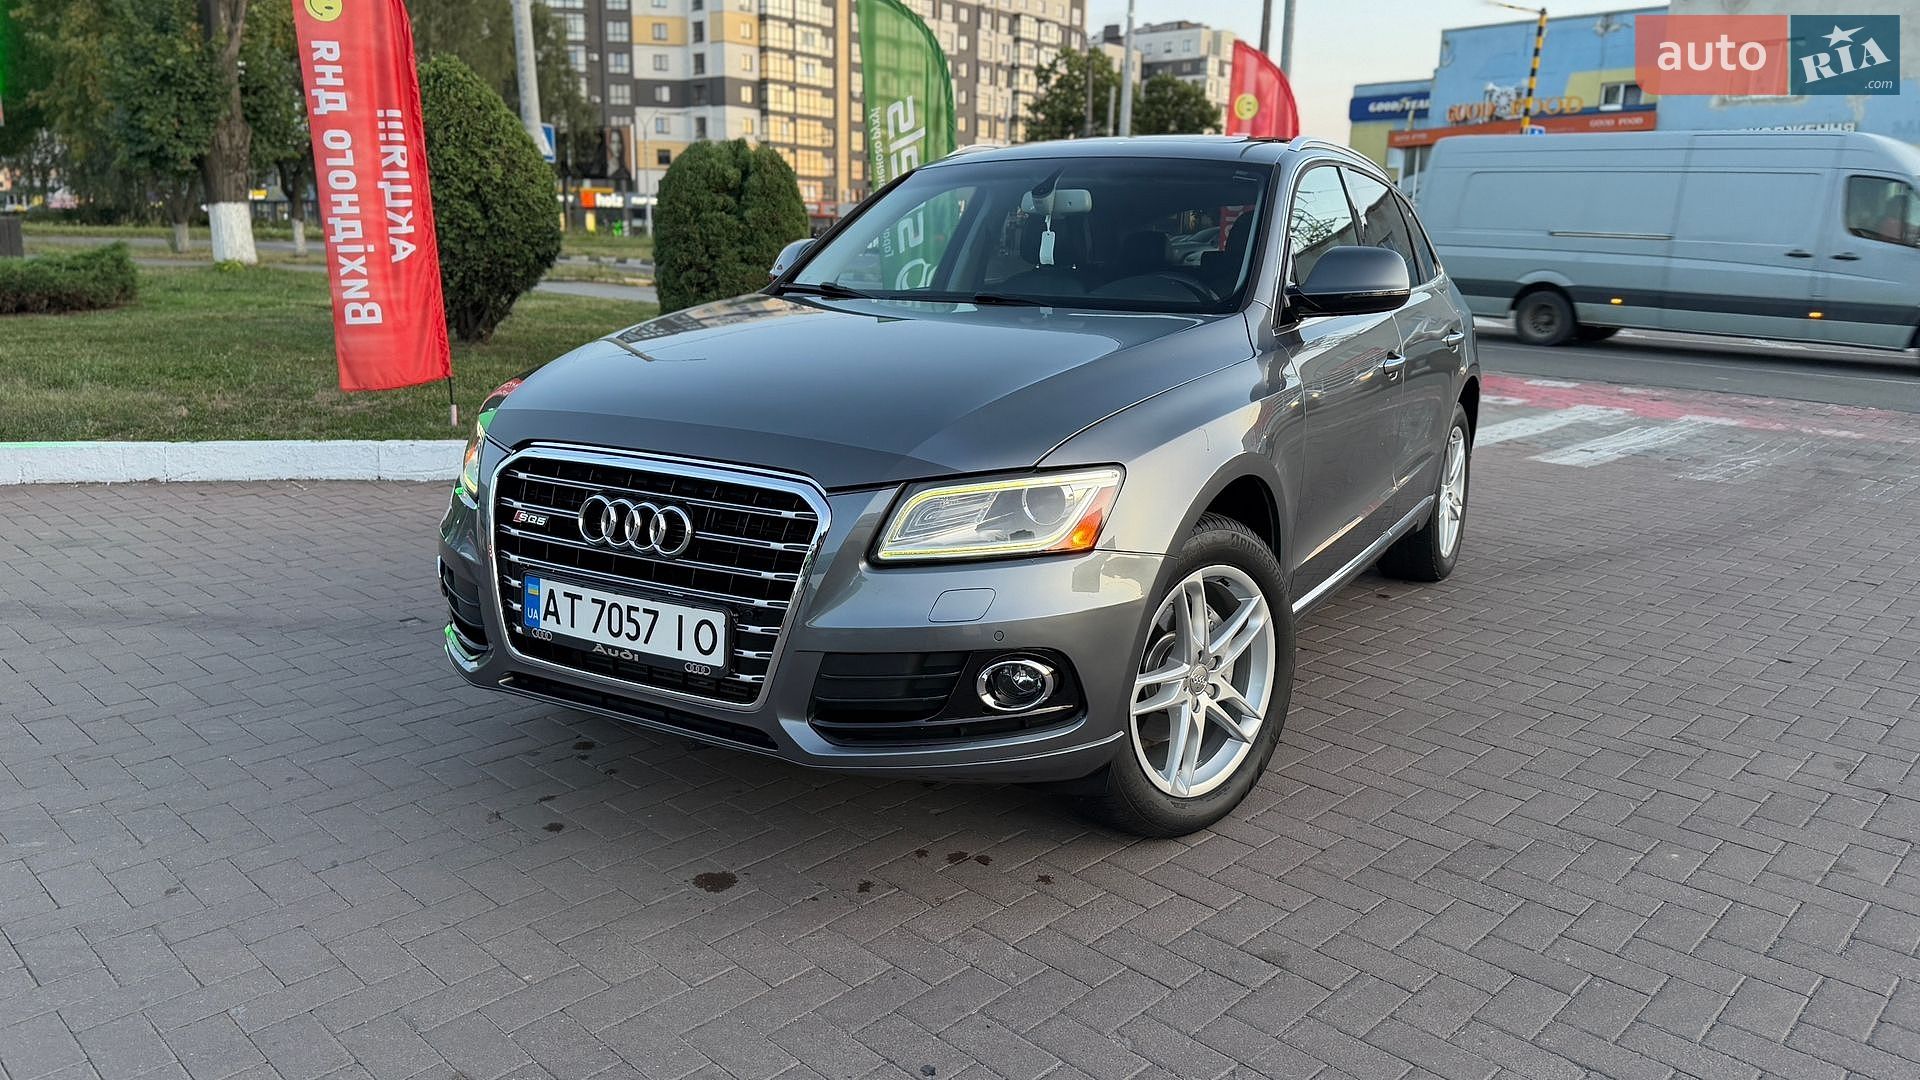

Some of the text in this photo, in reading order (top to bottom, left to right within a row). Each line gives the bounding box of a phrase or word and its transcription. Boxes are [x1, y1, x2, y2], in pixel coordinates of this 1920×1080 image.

[514, 510, 547, 526] SQ5
[527, 607, 539, 620] UA
[542, 588, 718, 656] AT 7057 IO
[592, 643, 640, 662] Audi
